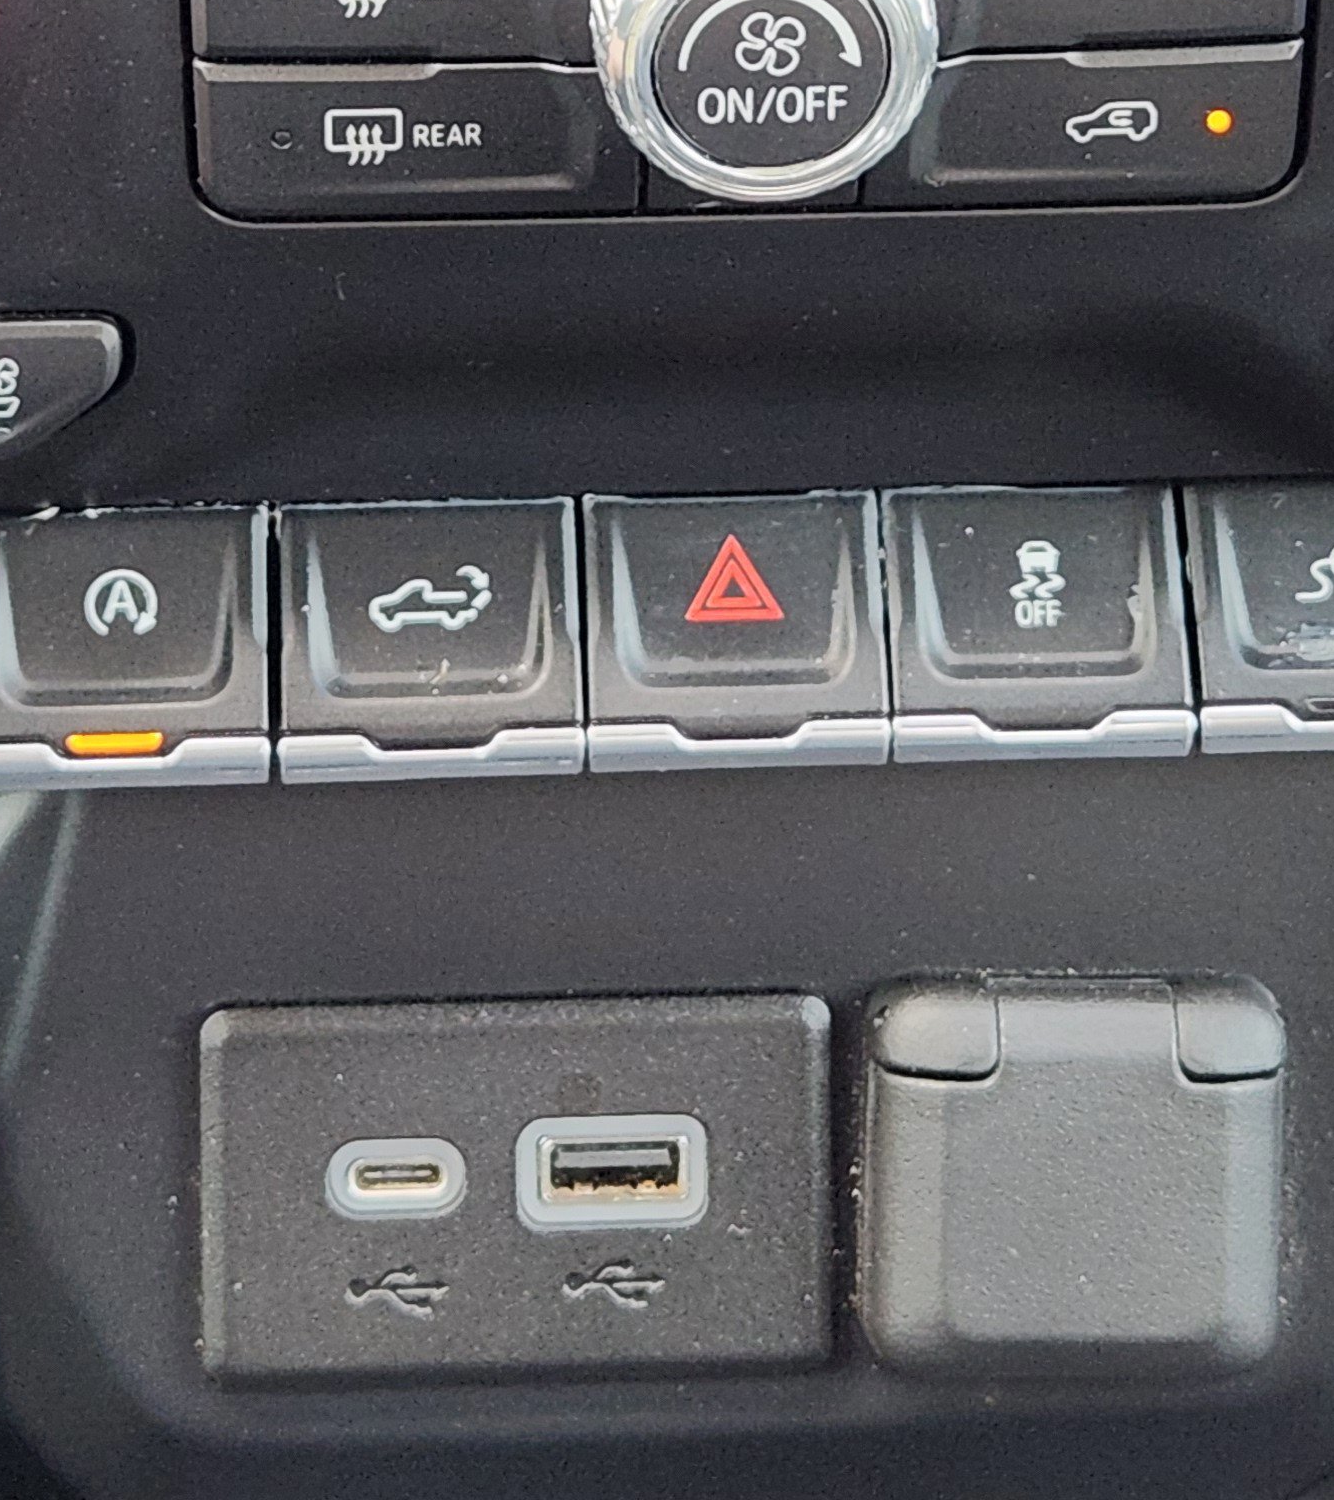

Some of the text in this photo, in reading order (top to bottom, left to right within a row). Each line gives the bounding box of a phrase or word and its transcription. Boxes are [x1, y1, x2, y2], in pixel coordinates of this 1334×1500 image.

[697, 85, 848, 124] ON/OFF
[412, 123, 481, 148] REAR
[102, 579, 141, 622] A
[1015, 598, 1065, 627] OFF
